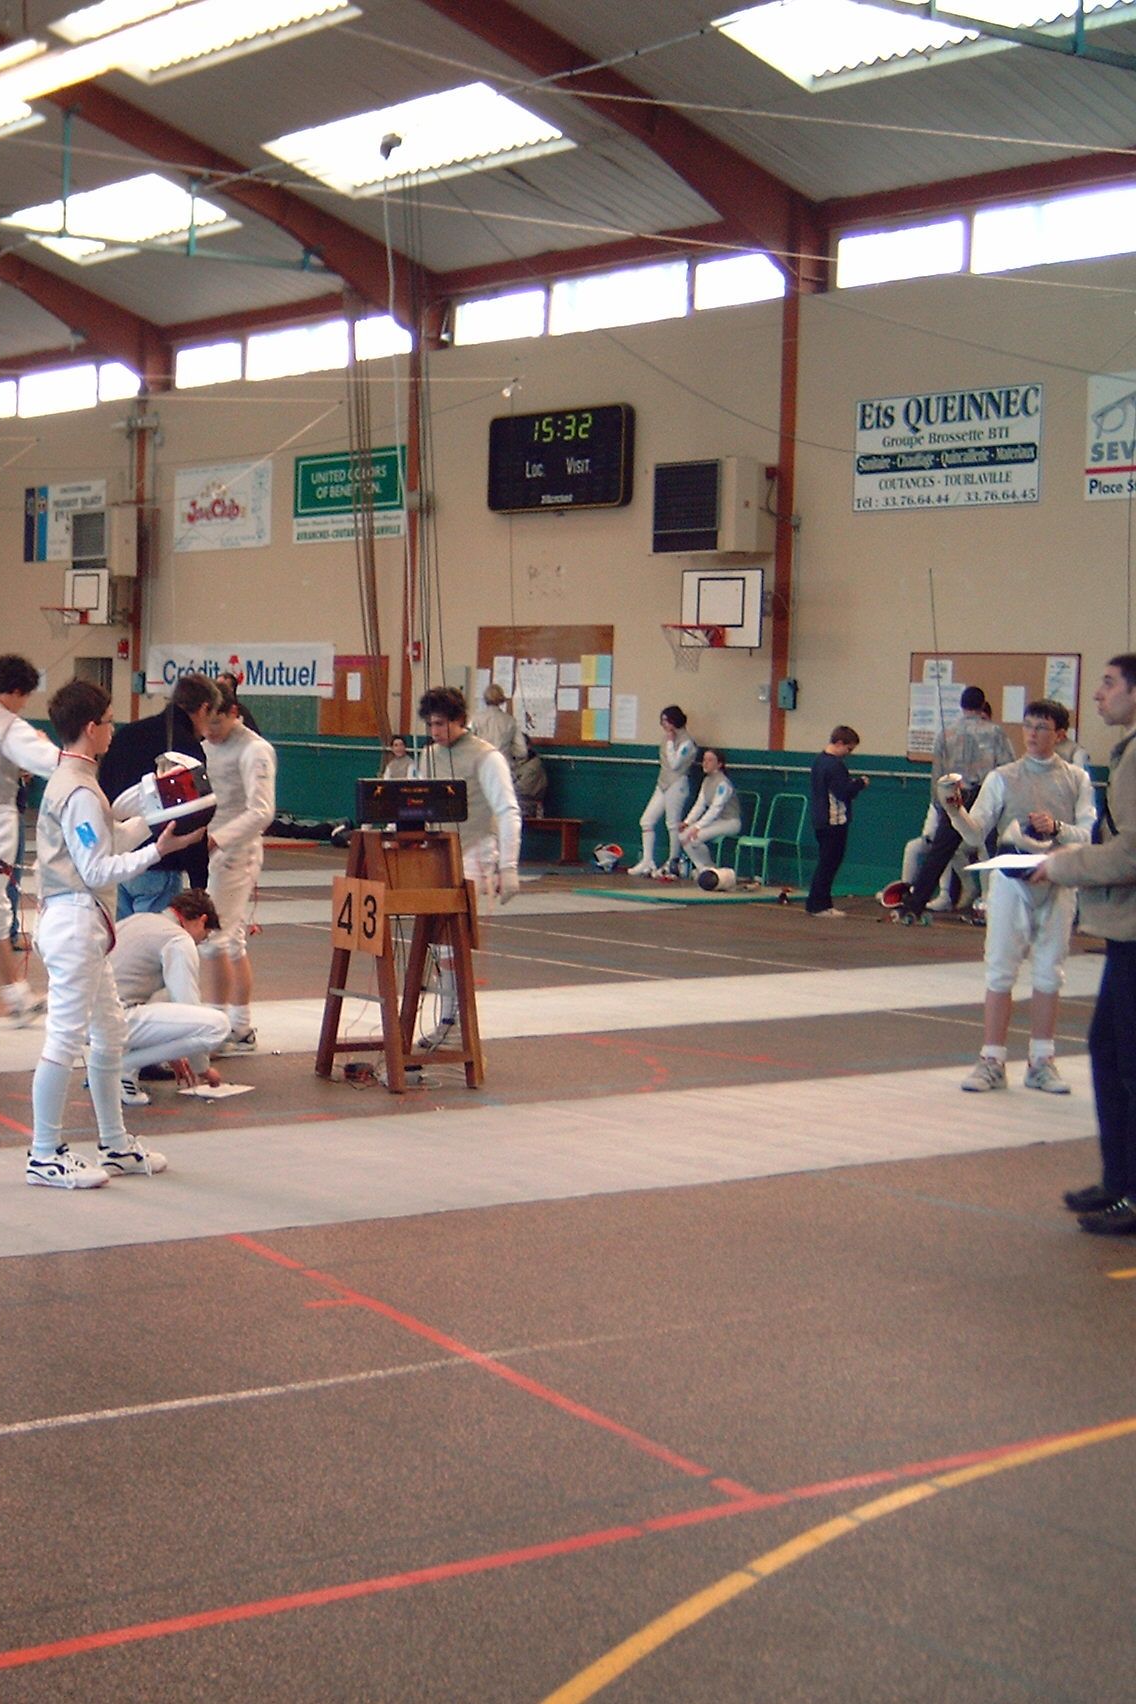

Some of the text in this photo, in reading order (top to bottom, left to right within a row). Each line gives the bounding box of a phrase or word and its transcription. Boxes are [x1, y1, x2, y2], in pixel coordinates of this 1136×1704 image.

[859, 386, 1040, 433] Ets QUEINNEC
[533, 413, 593, 442] 15:32
[882, 427, 1010, 450] Groupe Brossette BTI
[311, 469, 346, 484] UNITED
[879, 477, 934, 491] COUTANCES
[944, 471, 1012, 486] TOURLAVILLE
[1089, 479, 1123, 494] Place
[316, 486, 328, 499] OF
[246, 660, 317, 686] Mutuel
[337, 892, 377, 939] 43
